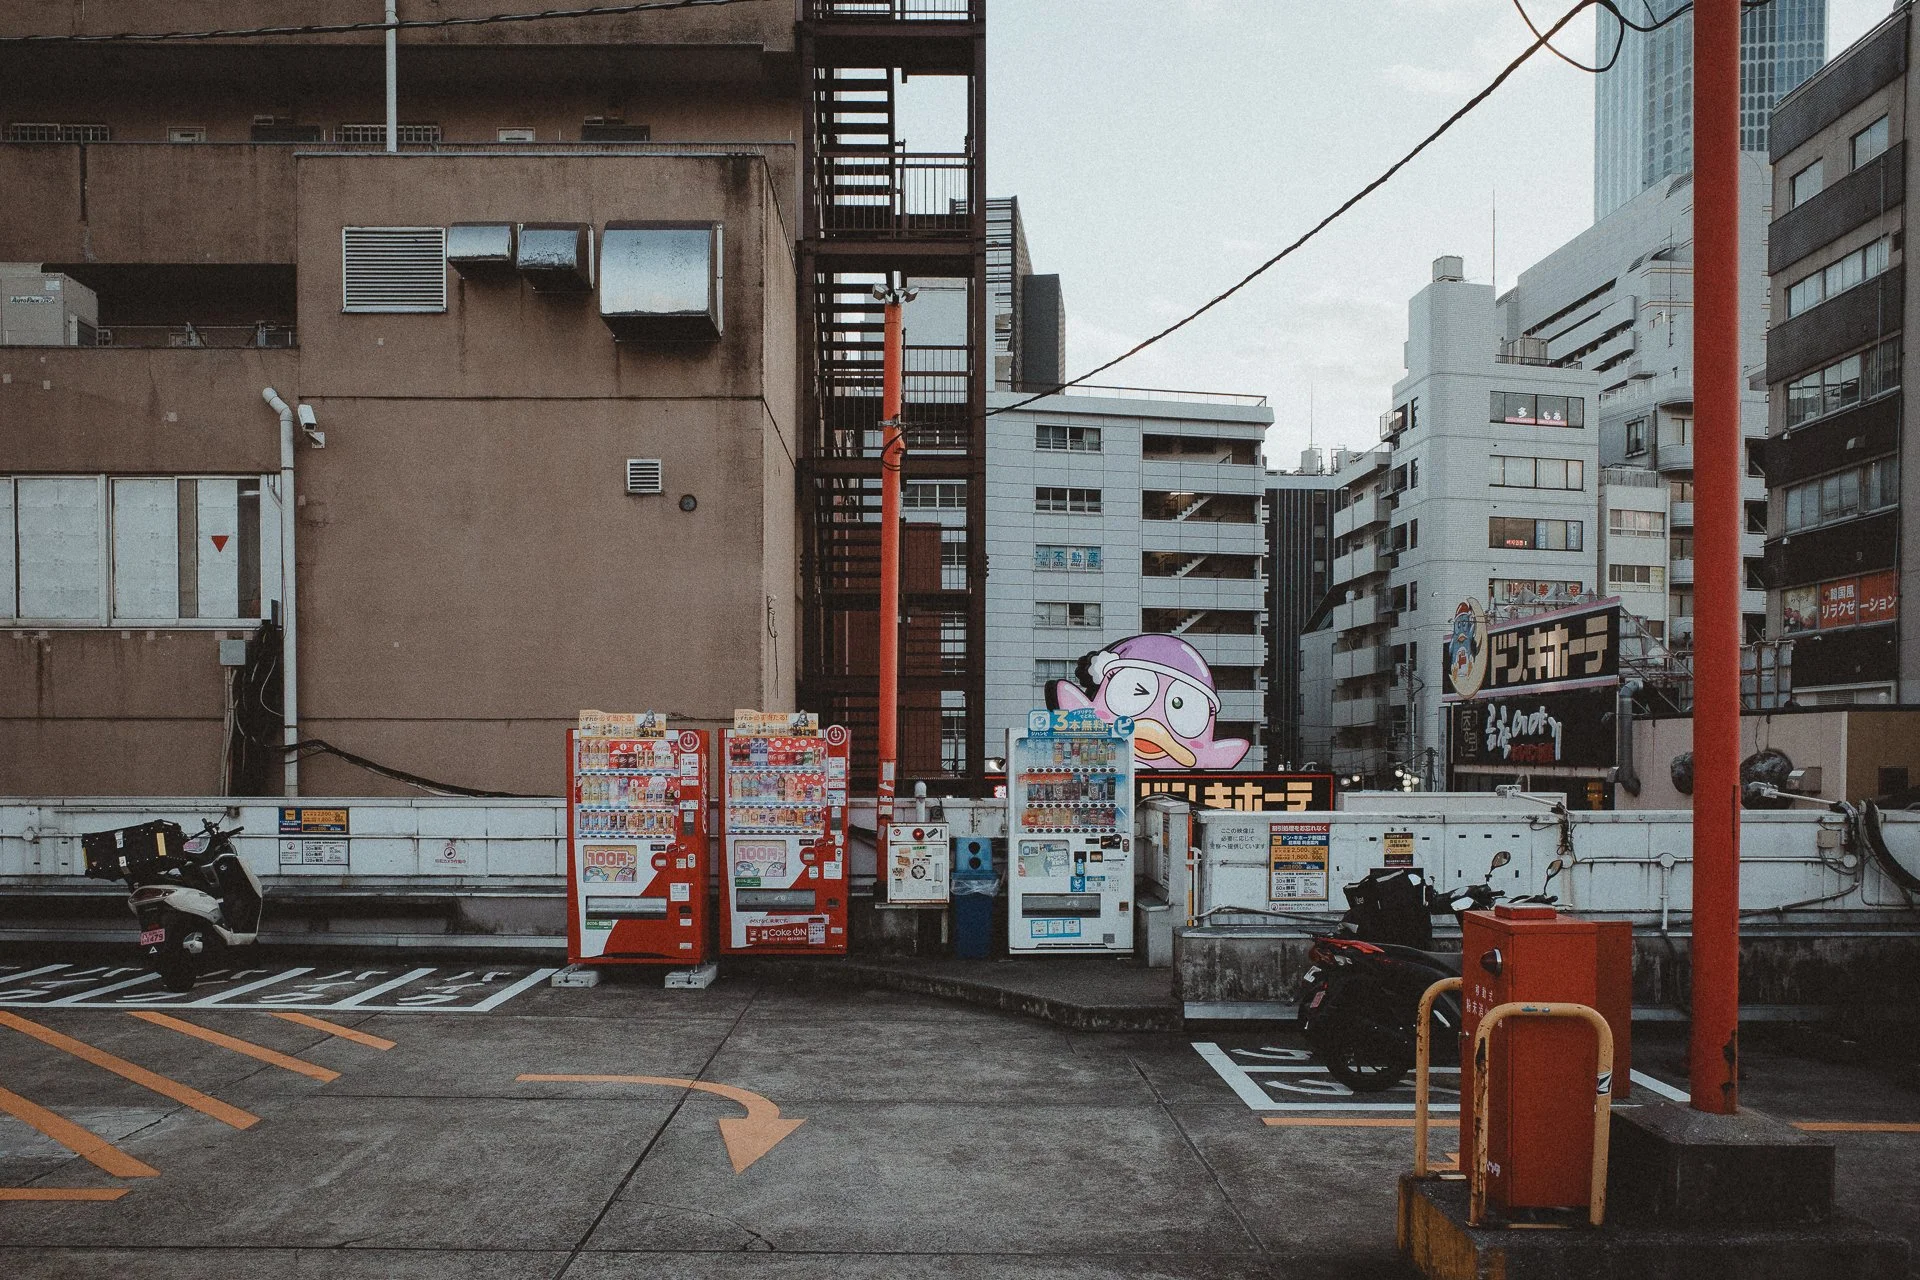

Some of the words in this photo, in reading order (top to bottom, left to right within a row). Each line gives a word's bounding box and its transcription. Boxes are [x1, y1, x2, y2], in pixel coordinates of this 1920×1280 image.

[1053, 551, 1099, 563] 不動産
[1830, 584, 1855, 600] 韓国風
[1822, 595, 1897, 619] リラクゼーション
[768, 928, 792, 937] Coke
[793, 927, 807, 936] ON
